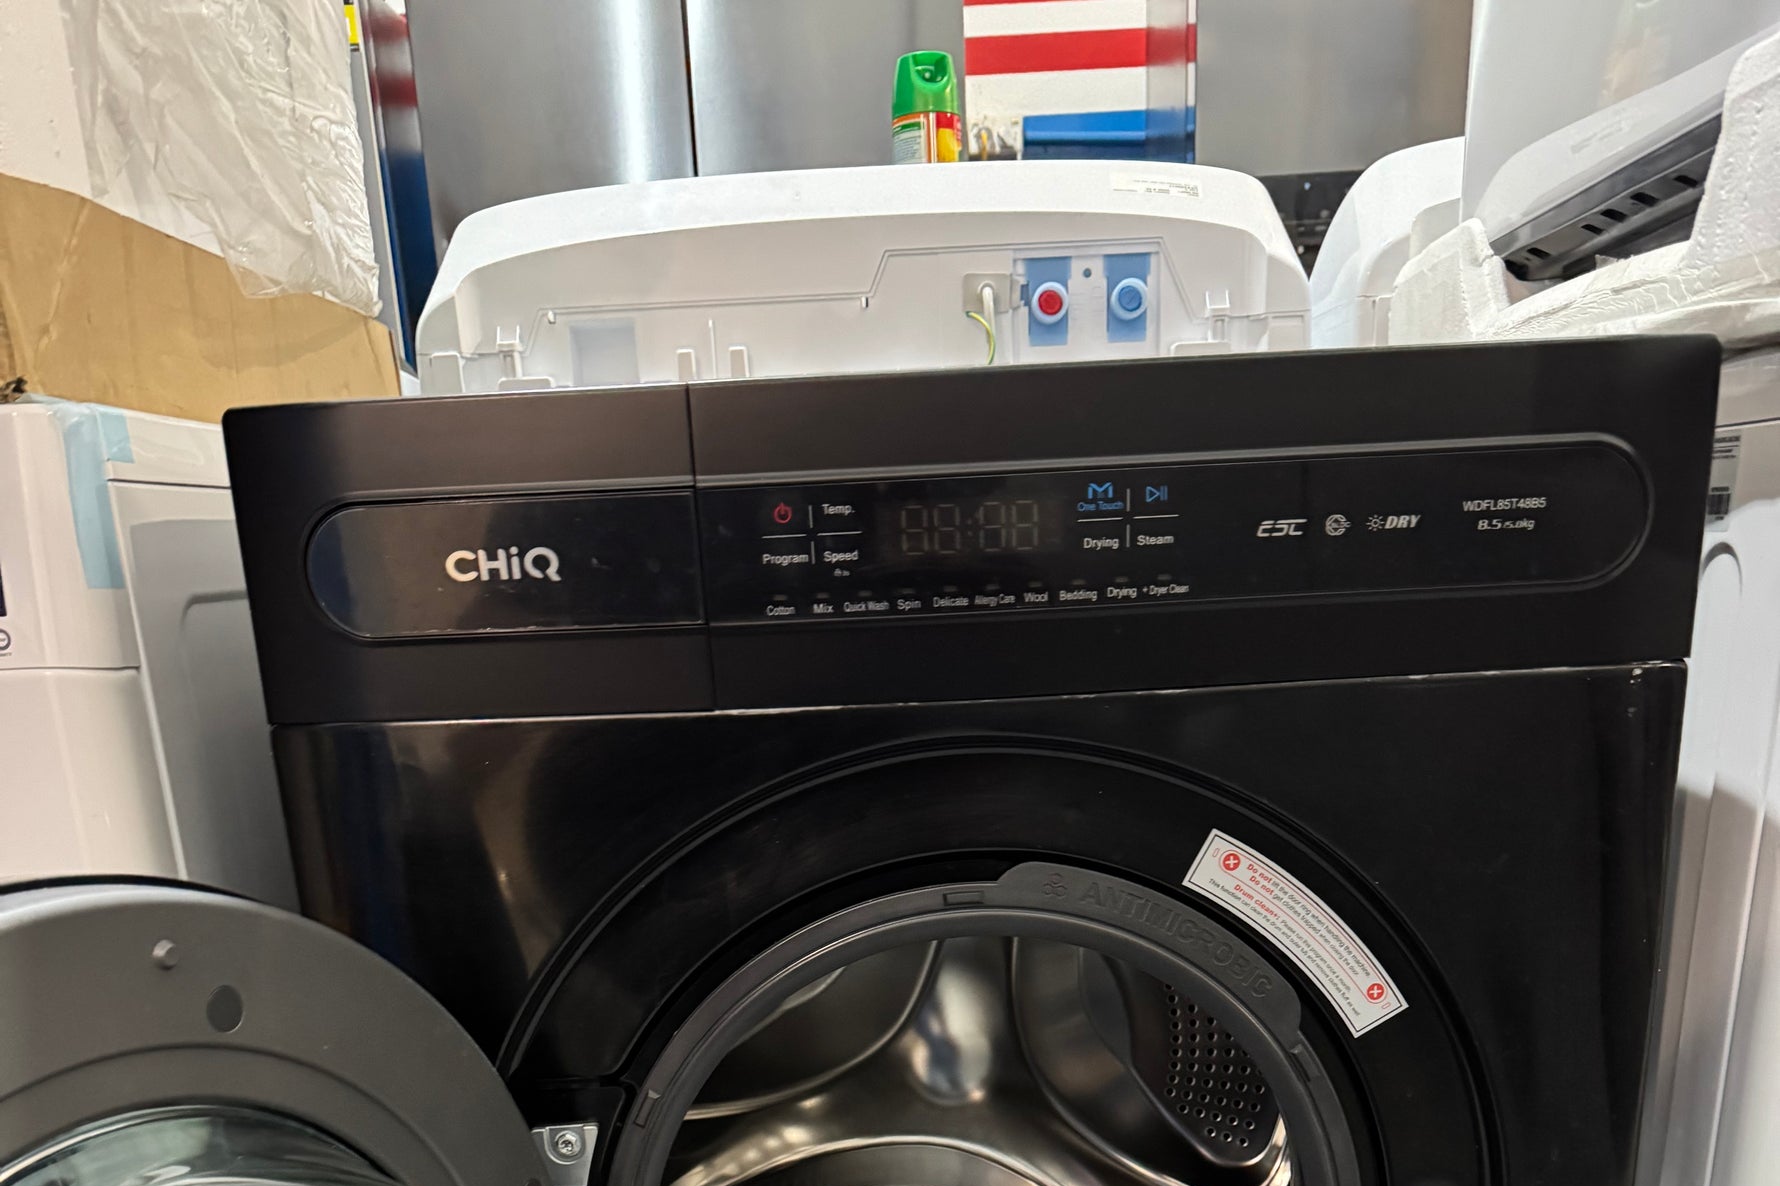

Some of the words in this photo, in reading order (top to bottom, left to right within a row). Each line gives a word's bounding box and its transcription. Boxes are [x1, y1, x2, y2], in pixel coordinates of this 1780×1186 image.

[821, 503, 856, 516] Temp.
[1077, 502, 1096, 511] One
[1098, 501, 1124, 510] Touch
[1384, 514, 1421, 529] DRY
[1083, 536, 1119, 550] Drying
[1136, 534, 1174, 546] Steam
[762, 553, 809, 567] Program
[823, 550, 859, 564] Speed
[445, 546, 562, 582] CHiQ
[1023, 591, 1049, 602] Wool
[1059, 589, 1098, 601] Bedding
[1107, 586, 1137, 599] Drying
[812, 603, 834, 614] Mix
[843, 602, 867, 612] Quick
[868, 600, 890, 611] Wash
[896, 599, 922, 612] Spin
[932, 596, 969, 608] Delicate
[766, 605, 796, 616] Cotton
[1246, 863, 1260, 874] Do
[1258, 872, 1273, 884] not
[1249, 875, 1261, 886] Do
[1260, 884, 1275, 895] not
[1234, 884, 1255, 901] Drum
